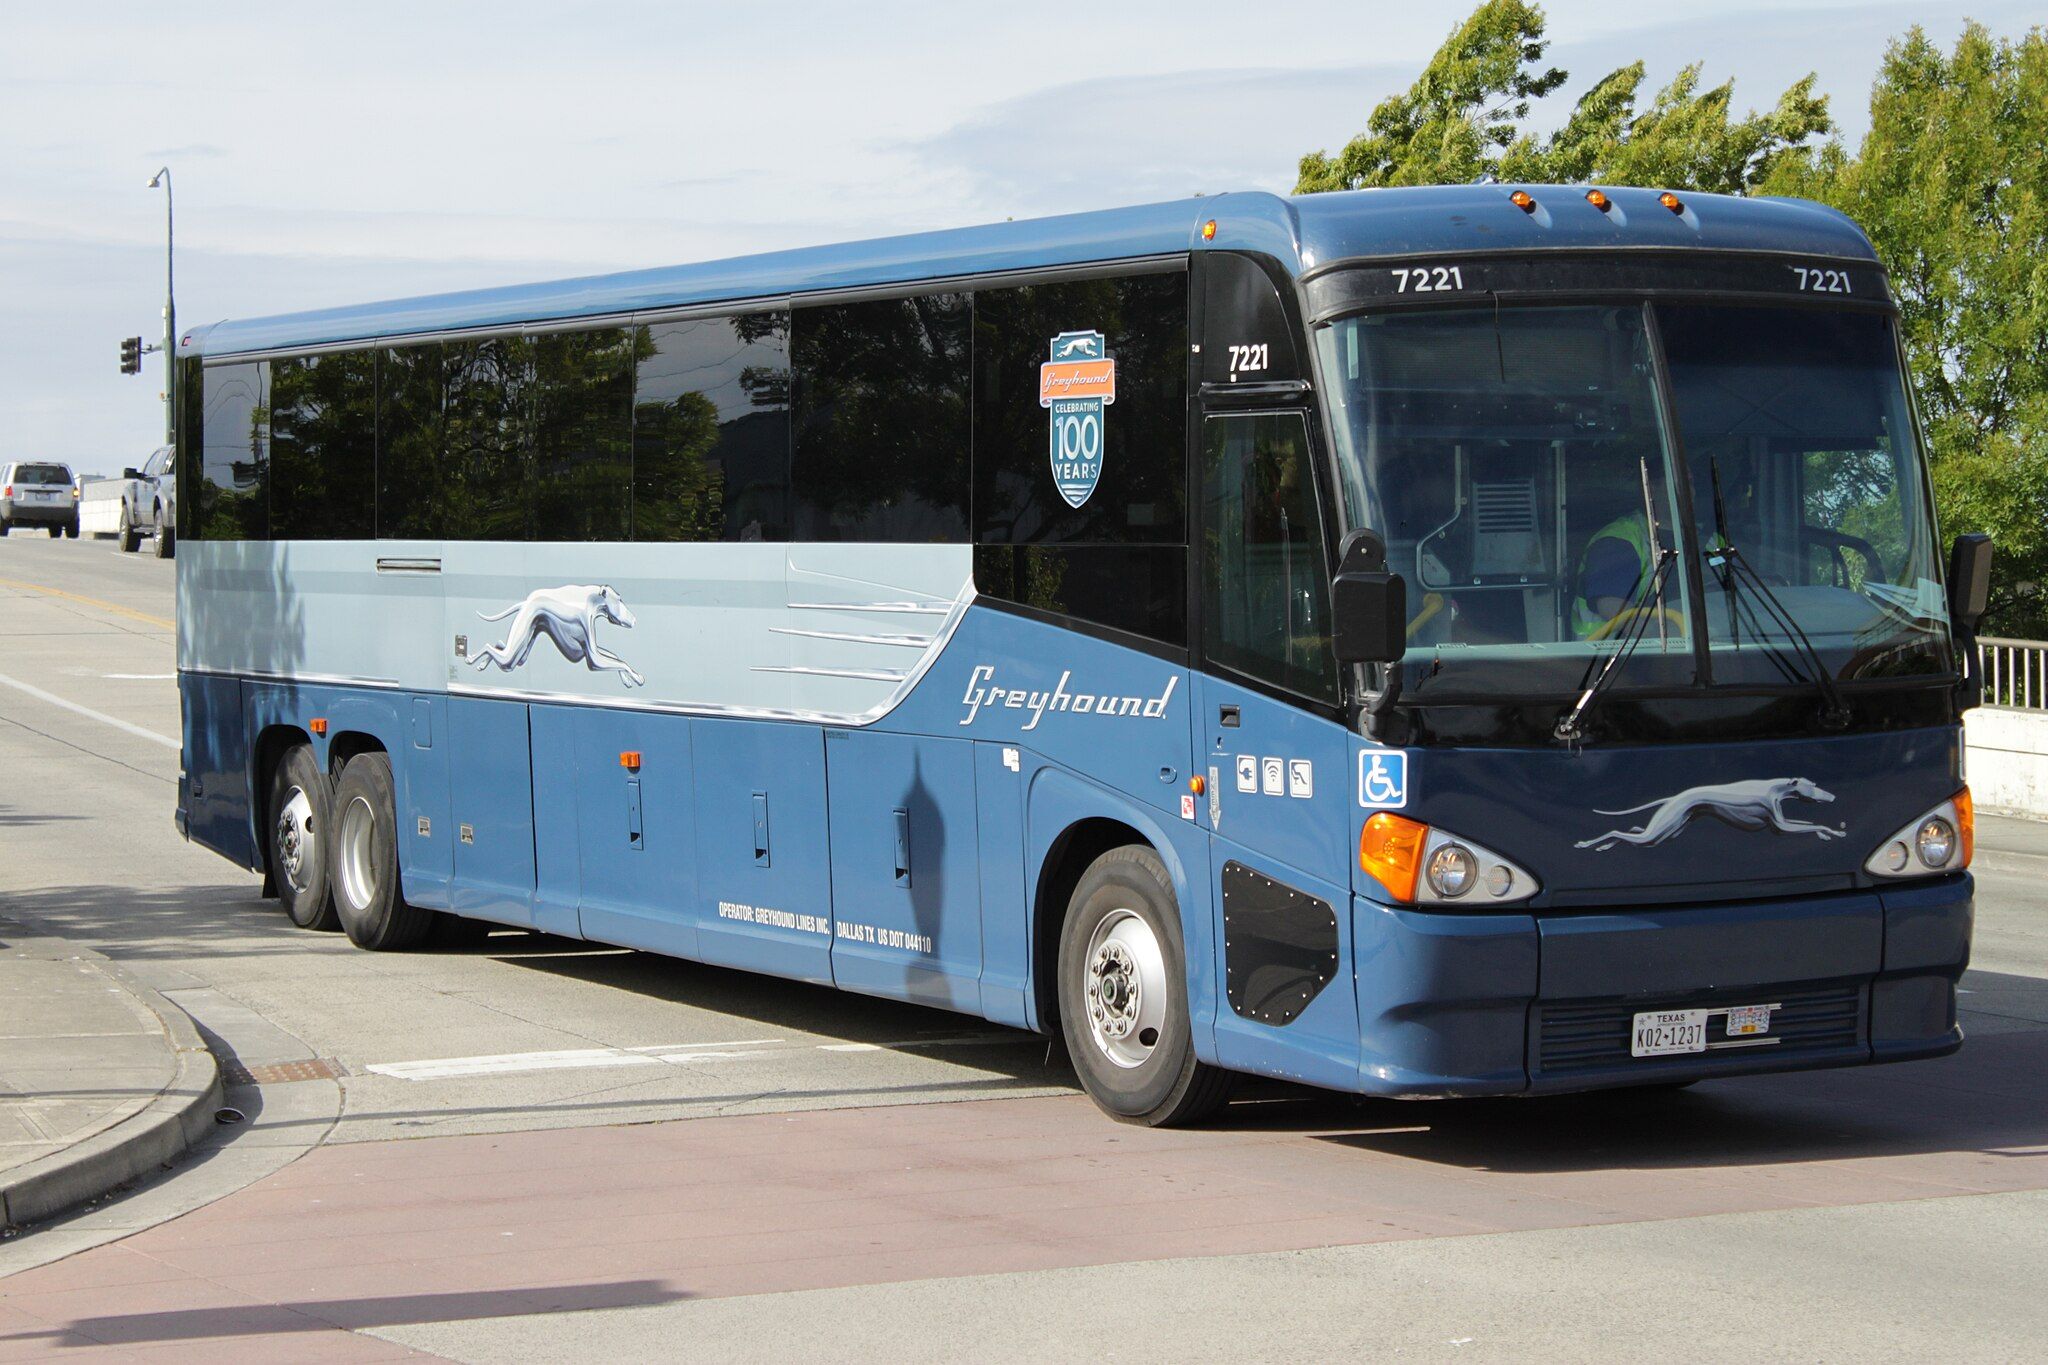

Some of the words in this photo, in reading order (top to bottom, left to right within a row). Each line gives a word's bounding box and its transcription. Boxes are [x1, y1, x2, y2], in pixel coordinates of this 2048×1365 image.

[1391, 266, 1463, 293] 7221
[1793, 267, 1852, 294] 7221
[1228, 343, 1269, 372] 7221
[1043, 368, 1112, 393] Greyhound
[1055, 401, 1099, 414] CELEBRATING
[1055, 414, 1099, 461] 100
[1055, 462, 1098, 481] YEARS
[959, 664, 1179, 731] Greyhound
[718, 901, 755, 922] OPERATOR:
[755, 907, 796, 930] GREYHOUND
[796, 914, 816, 933] LINES
[816, 917, 830, 935] INC.
[837, 921, 864, 942] DALLAS
[864, 925, 875, 944] TX
[877, 928, 888, 946] US
[889, 930, 904, 949] DOT
[905, 935, 932, 954] 044110
[1657, 1013, 1686, 1023] TEXAS
